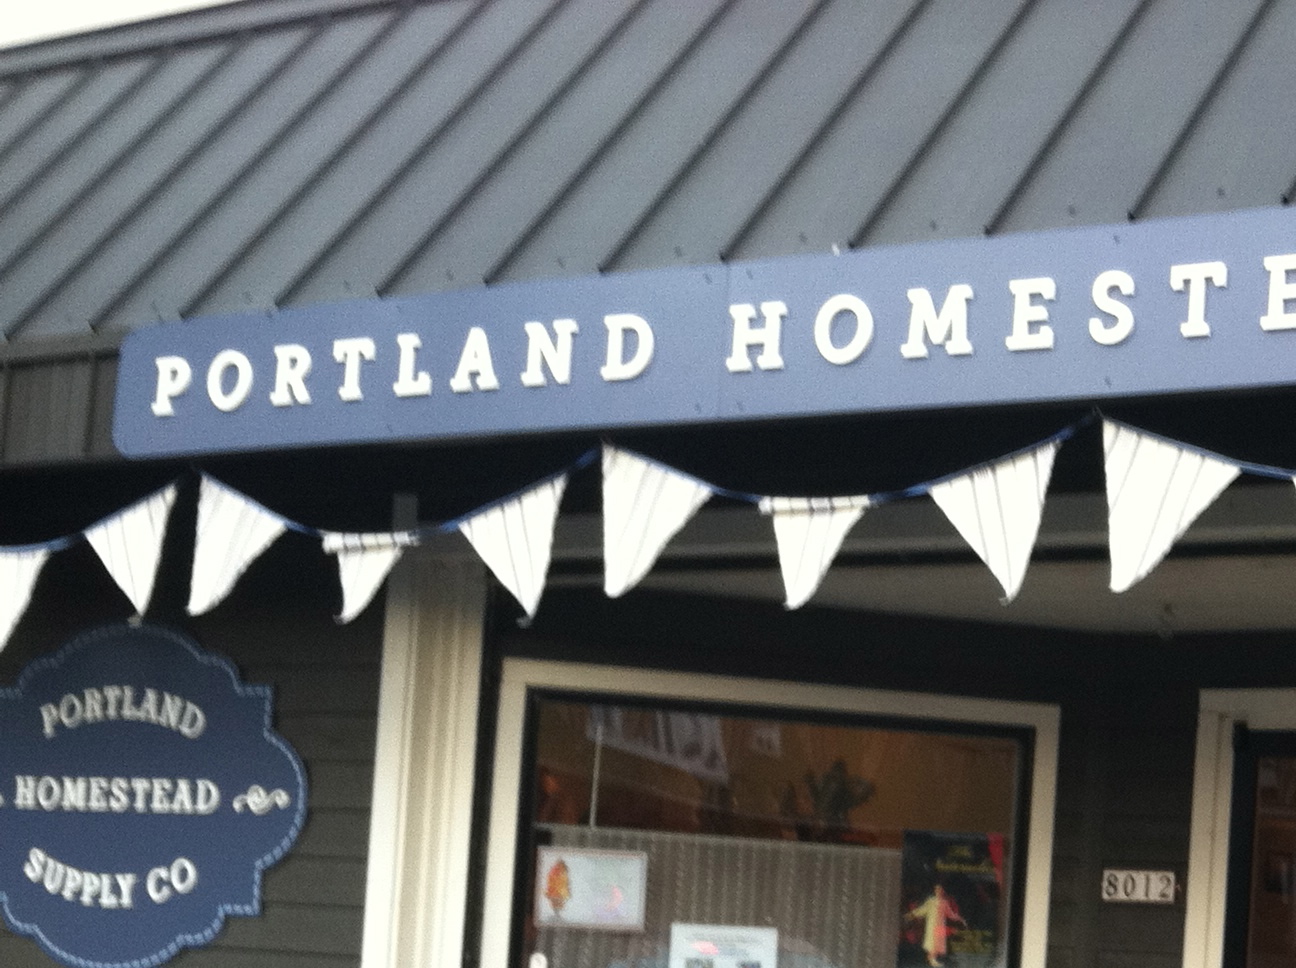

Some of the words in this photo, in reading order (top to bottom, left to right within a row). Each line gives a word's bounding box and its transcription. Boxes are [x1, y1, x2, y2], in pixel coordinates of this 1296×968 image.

[150, 313, 656, 416] PORTLAND
[40, 685, 207, 739] PORTLAND
[14, 775, 221, 815] HOMESTEAD
[23, 847, 136, 909] SUPPLY
[146, 857, 198, 904] CO
[1105, 872, 1172, 898] 8012
